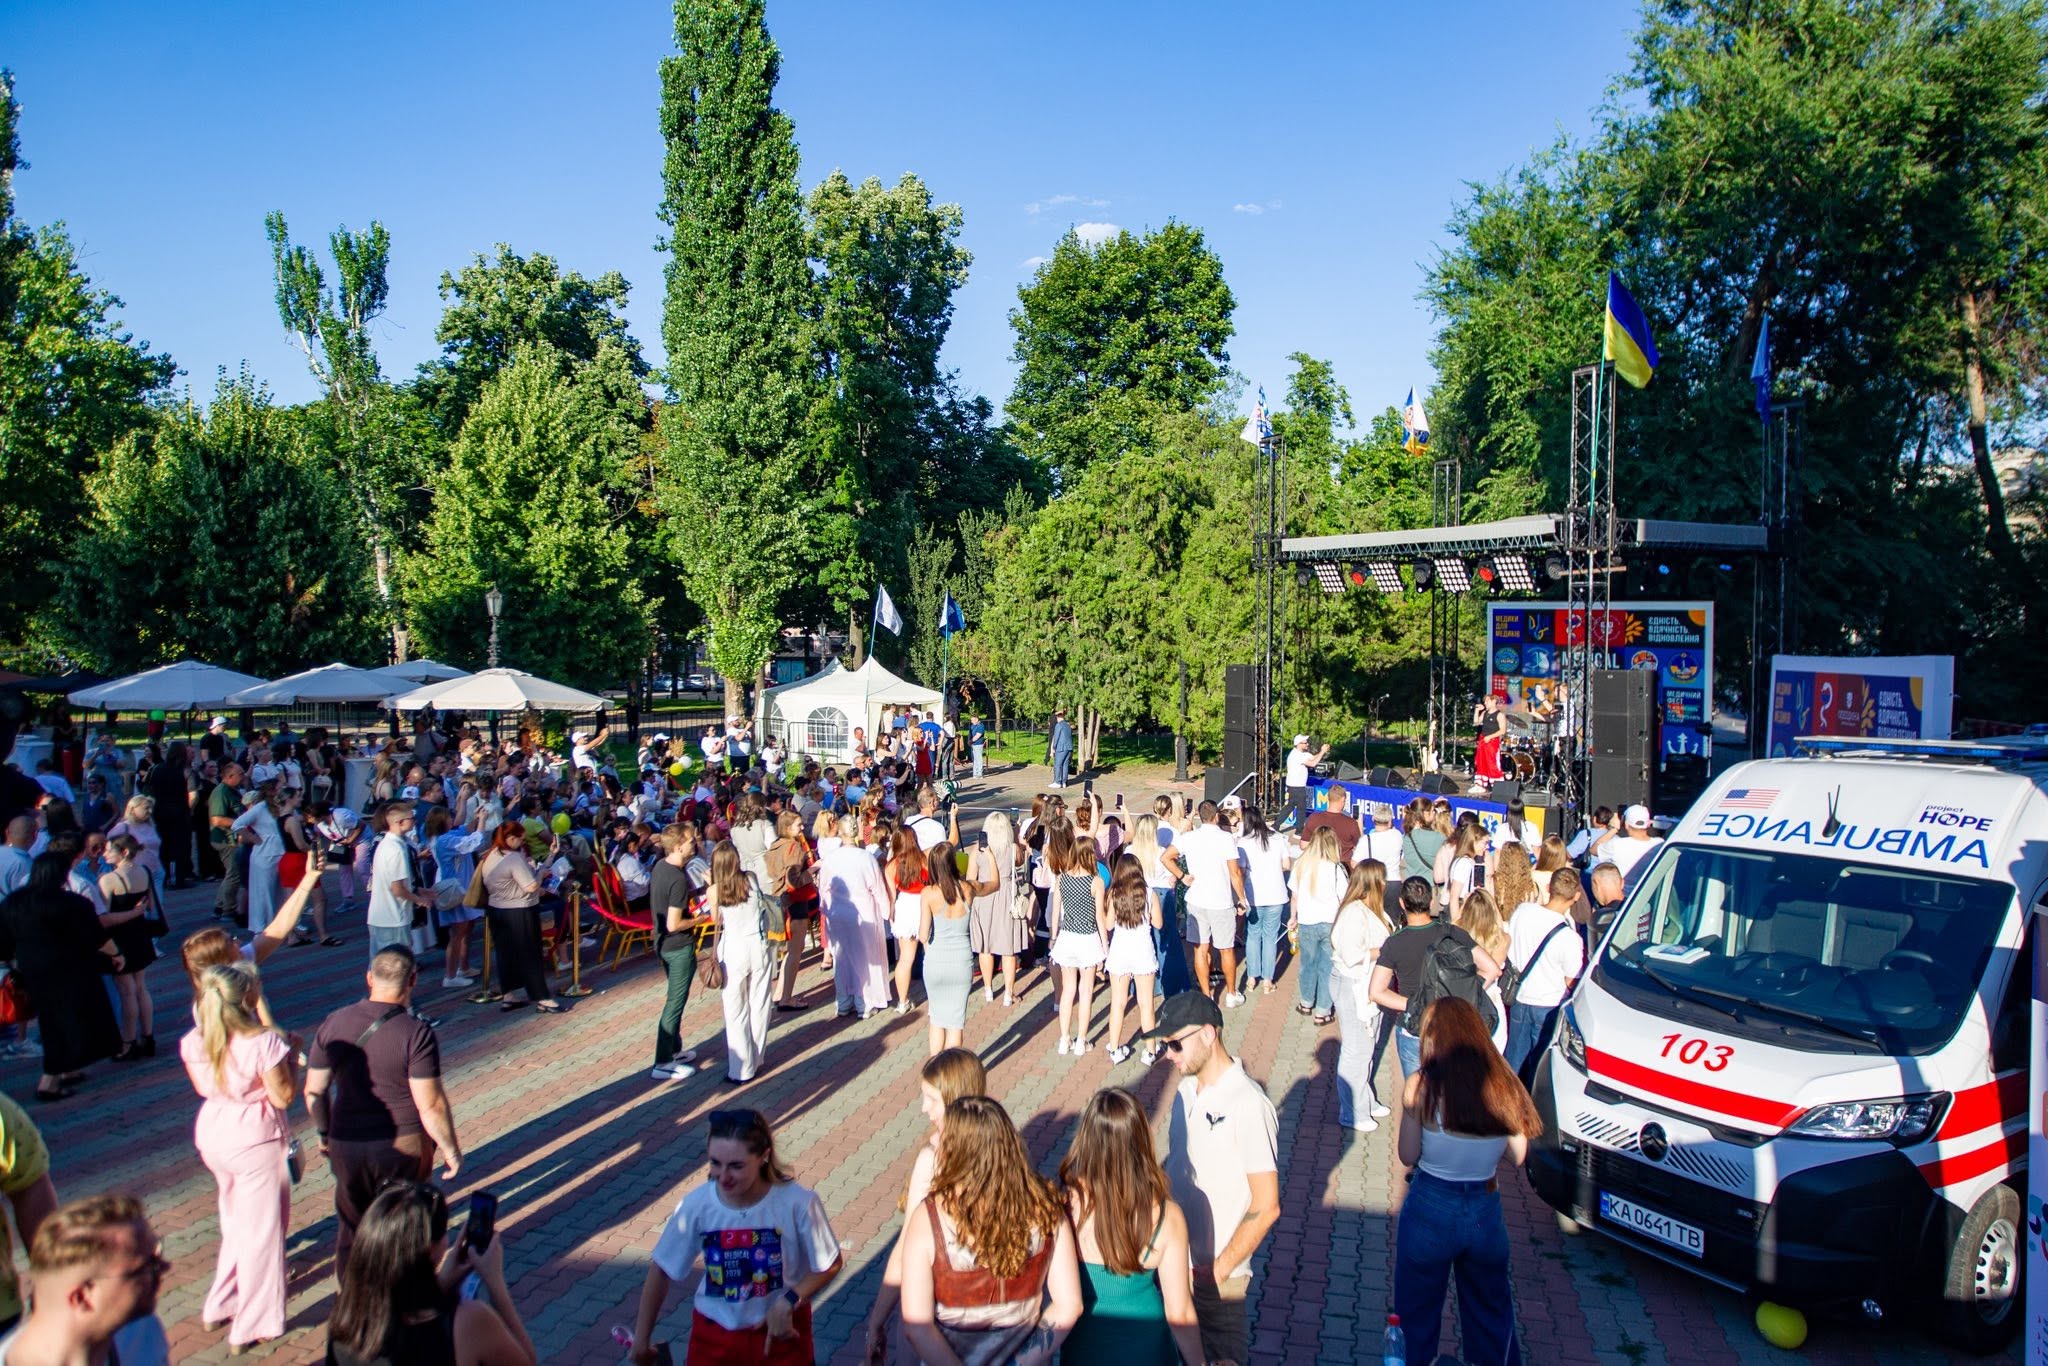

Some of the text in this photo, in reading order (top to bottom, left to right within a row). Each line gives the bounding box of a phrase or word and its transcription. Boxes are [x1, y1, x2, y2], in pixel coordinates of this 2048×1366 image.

[1918, 810, 1993, 831] HOPE
[1925, 804, 1964, 813] project
[1660, 1033, 1735, 1072] 103
[1609, 1197, 1700, 1249] KA 0641 TB
